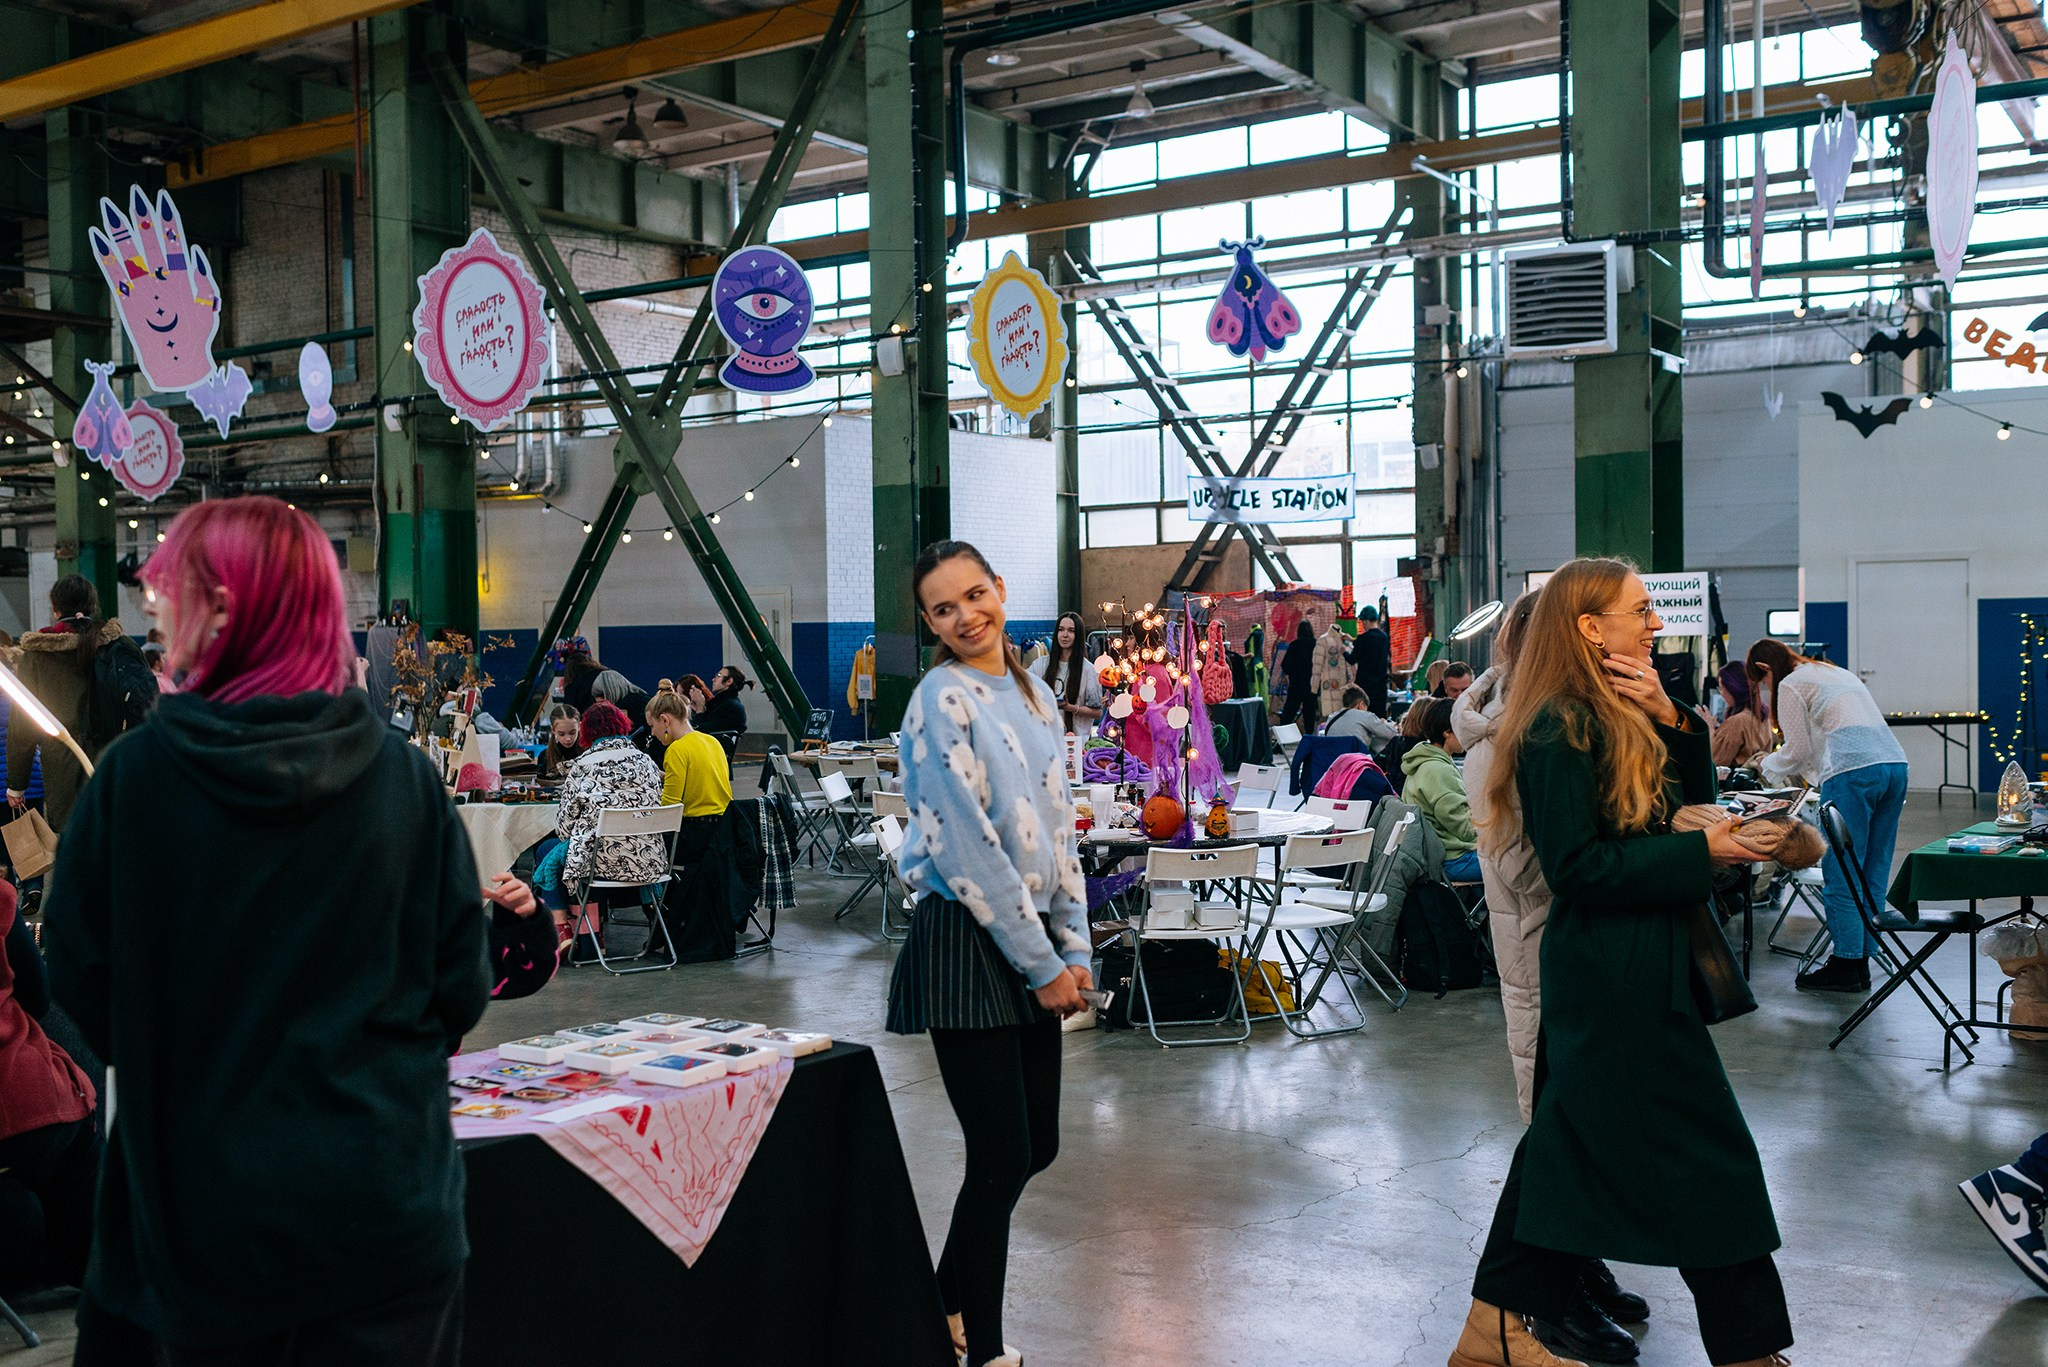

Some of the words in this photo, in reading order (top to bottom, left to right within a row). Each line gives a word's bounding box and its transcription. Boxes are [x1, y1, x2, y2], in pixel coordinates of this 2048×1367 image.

[456, 292, 506, 328] СЛАДОСТЬ
[996, 303, 1032, 335] СЛАДОСТЬ
[472, 316, 494, 343] ИЛИ
[1008, 324, 1025, 348] ИЛИ
[1963, 317, 2048, 374] ВЕД
[1645, 577, 1701, 592] ДУЮЩИЙ
[1654, 594, 1702, 608] АЖНЫЙ
